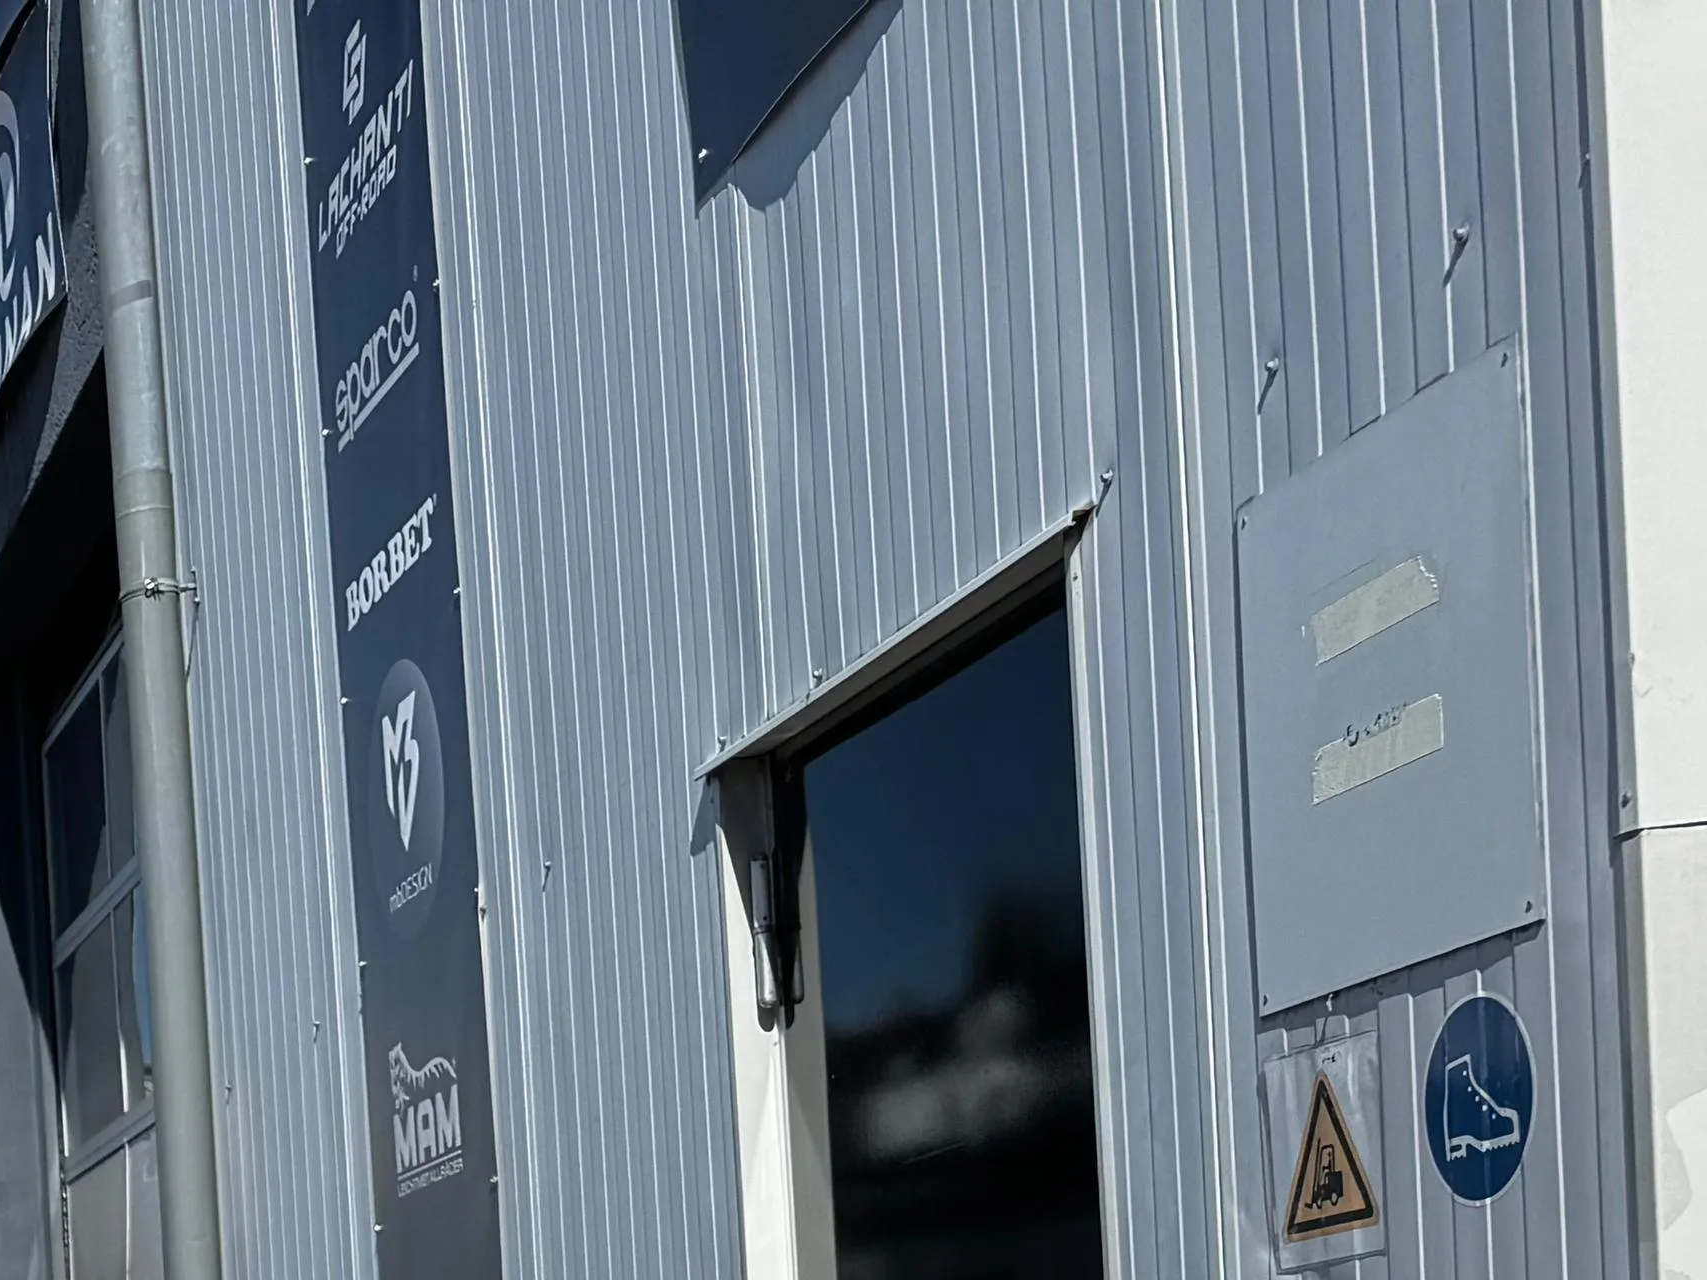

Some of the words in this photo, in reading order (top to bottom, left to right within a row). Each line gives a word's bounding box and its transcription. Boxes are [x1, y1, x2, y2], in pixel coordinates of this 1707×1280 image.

[318, 59, 413, 253] LACHANTI
[334, 289, 419, 442] sparco
[344, 497, 434, 632] BORBET
[393, 1083, 463, 1174] MAM
